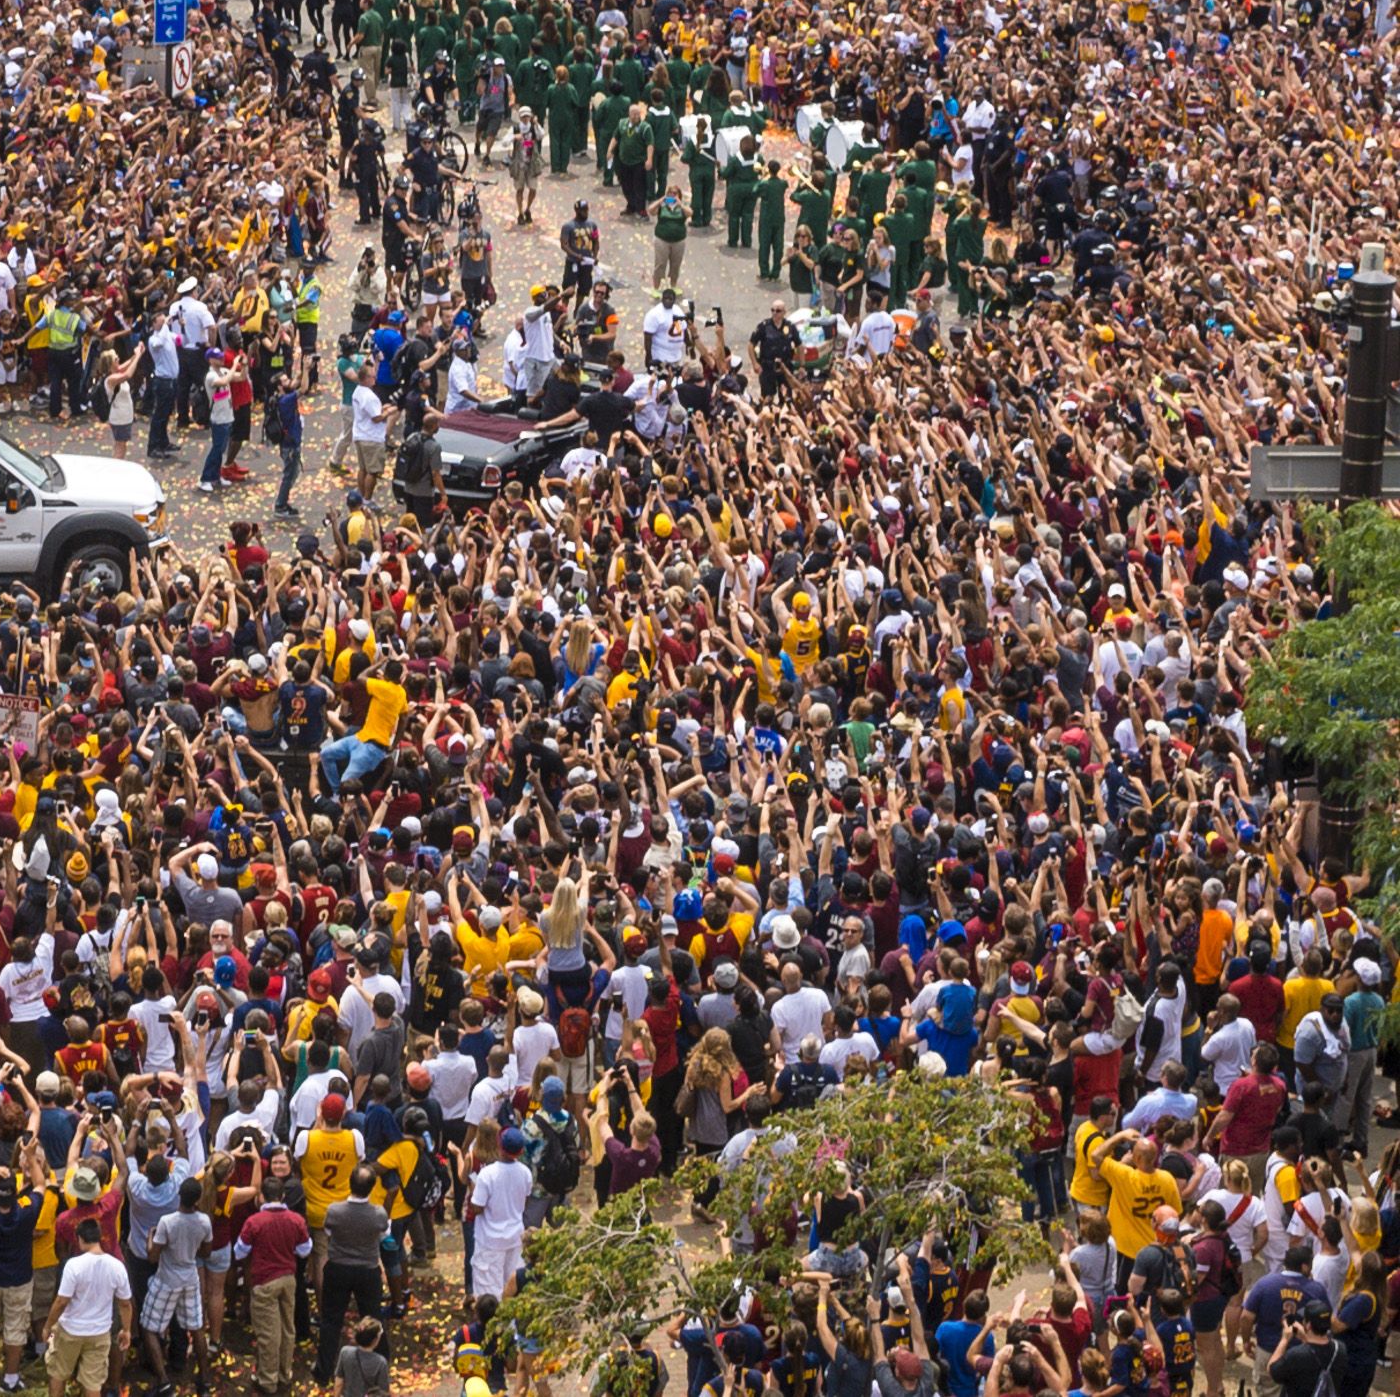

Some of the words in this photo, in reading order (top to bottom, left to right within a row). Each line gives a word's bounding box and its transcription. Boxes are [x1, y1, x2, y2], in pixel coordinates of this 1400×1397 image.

[796, 640, 811, 656] 5
[291, 697, 306, 719] 2
[316, 1151, 347, 1163] IRVING
[322, 1164, 339, 1191] 2
[764, 1325, 782, 1350] 2
